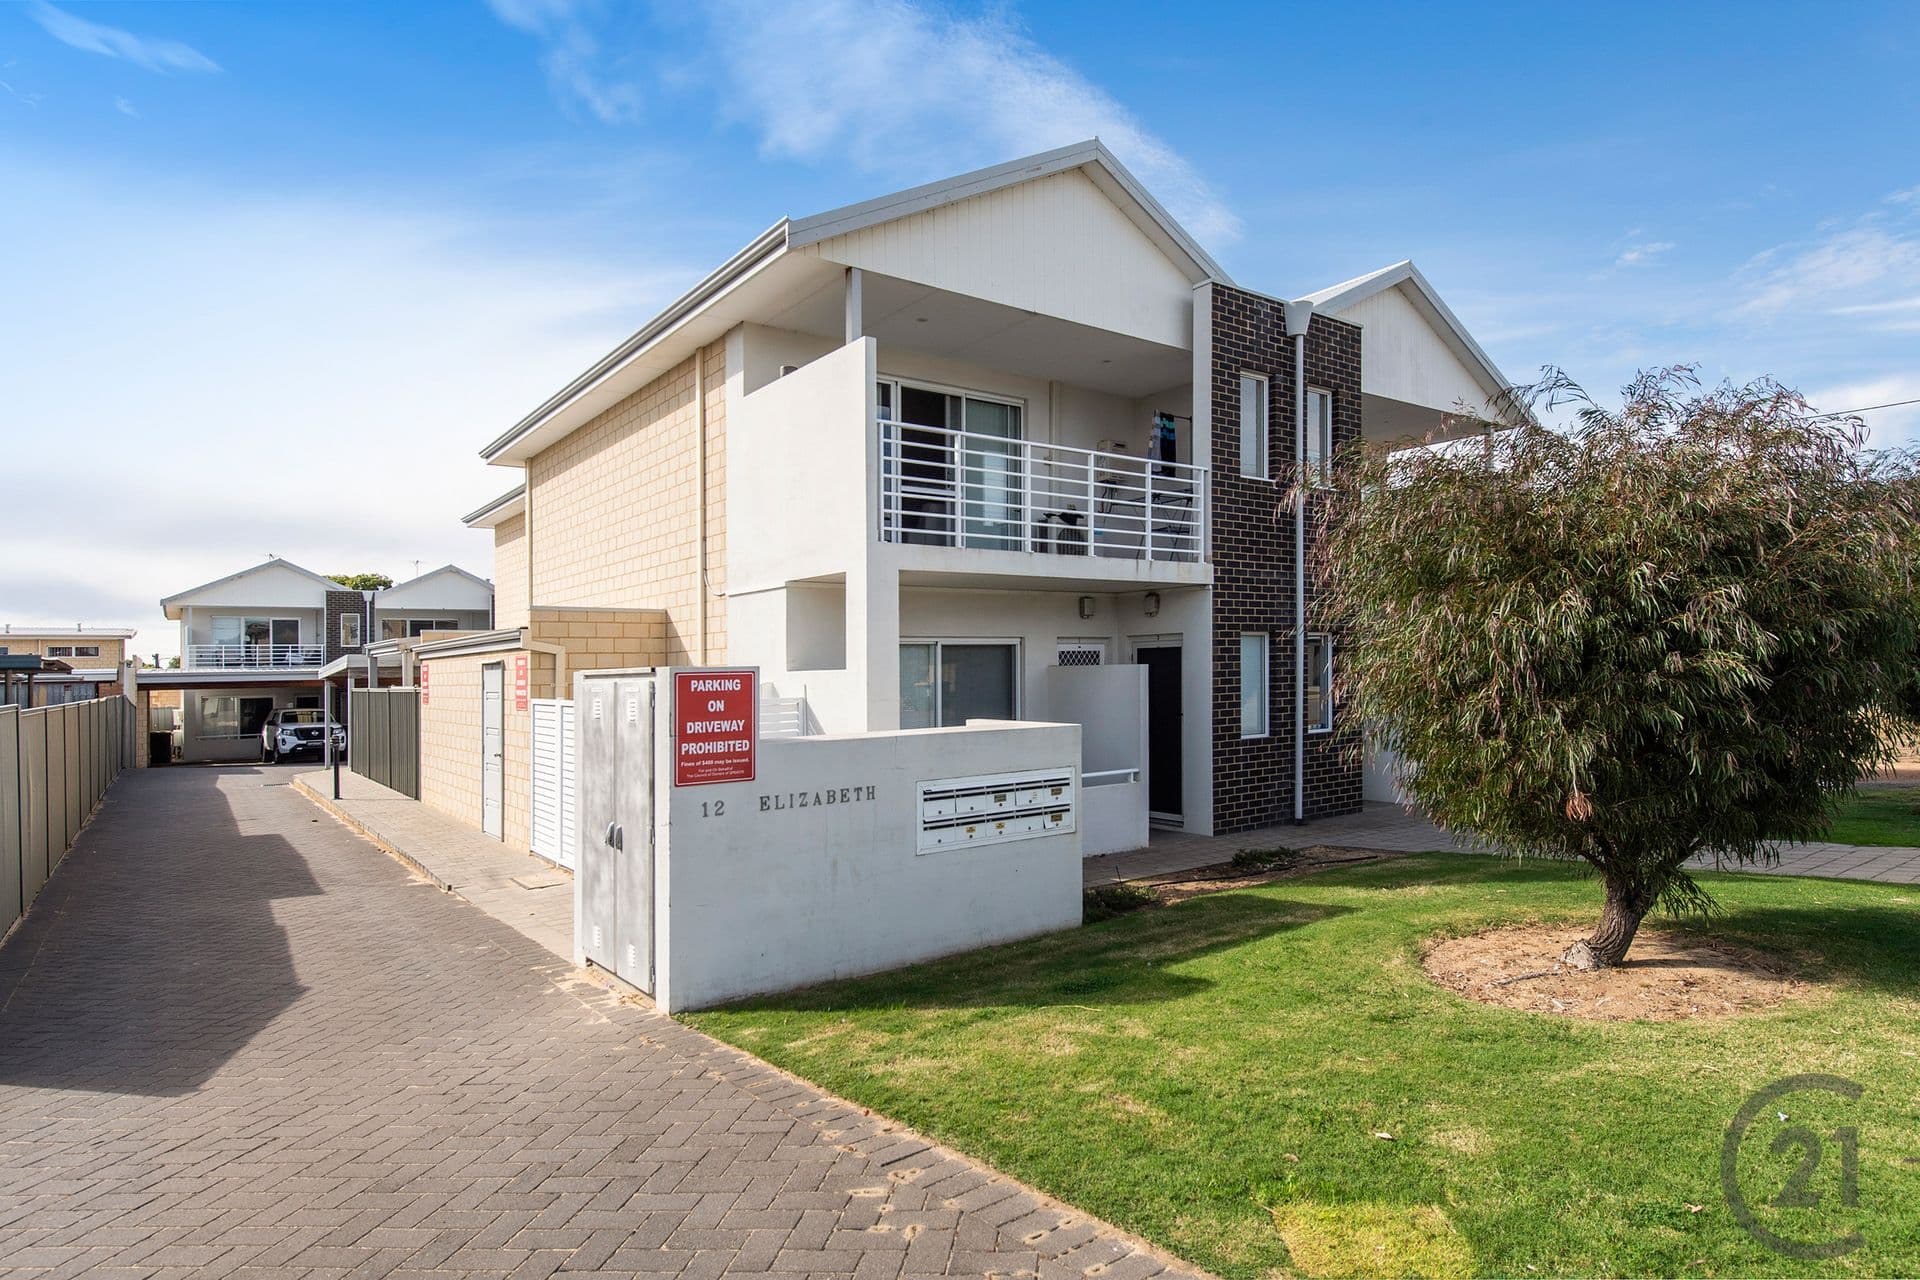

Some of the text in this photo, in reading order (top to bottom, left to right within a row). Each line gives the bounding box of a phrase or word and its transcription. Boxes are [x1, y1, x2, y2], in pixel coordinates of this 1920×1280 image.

[690, 679, 741, 692] PARKING
[707, 700, 725, 712] ON
[686, 719, 745, 734] DRIVEWAY
[681, 739, 750, 755] PROHIBITED
[701, 785, 876, 818] 12 ELIZABETH
